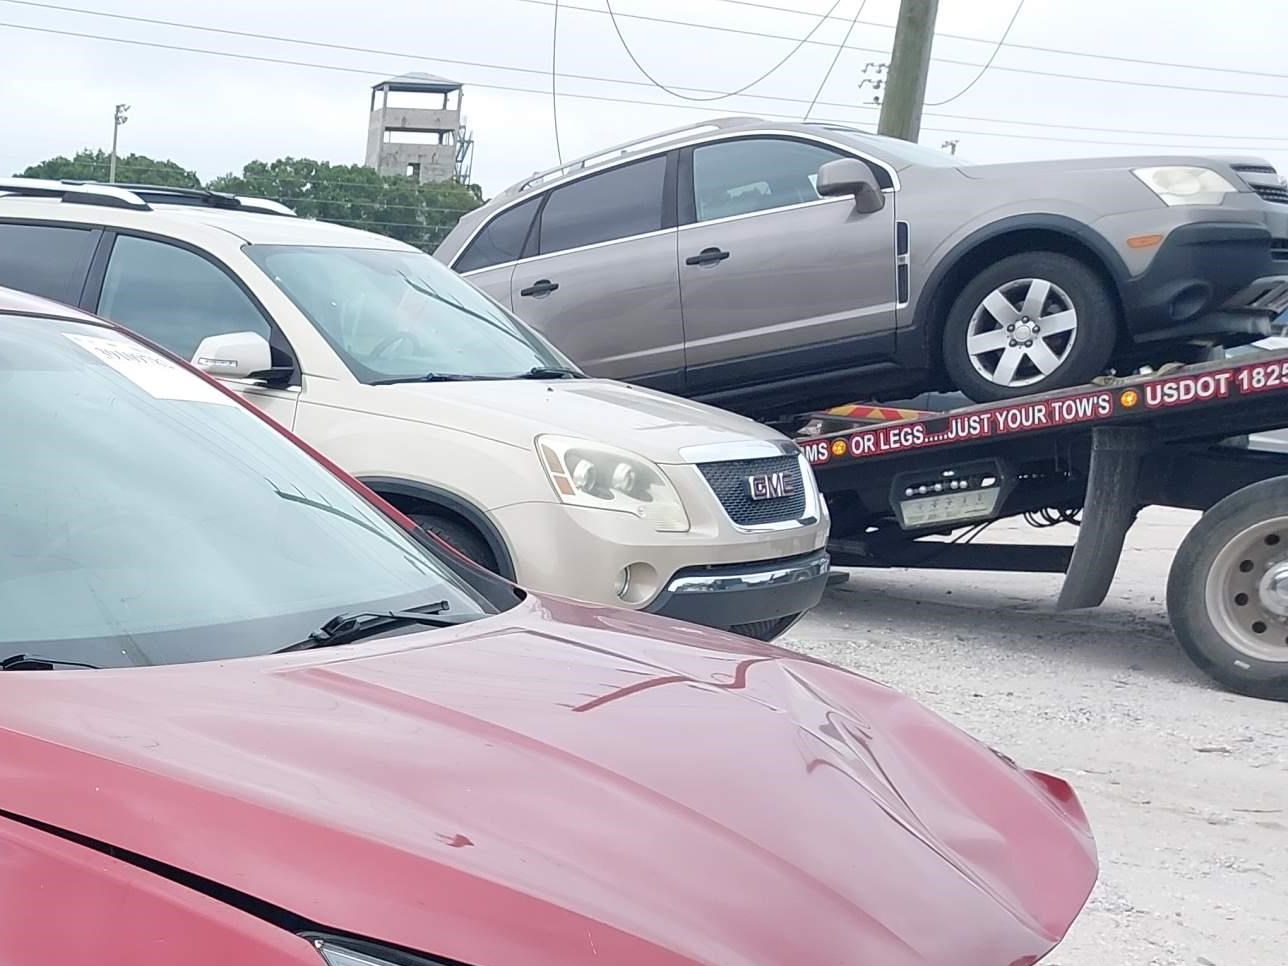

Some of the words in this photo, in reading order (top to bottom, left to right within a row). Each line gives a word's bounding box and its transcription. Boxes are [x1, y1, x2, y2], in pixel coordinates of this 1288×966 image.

[1146, 373, 1230, 405] USDOT
[851, 435, 874, 454] OR
[996, 405, 1046, 431] YOUR
[1051, 394, 1110, 422] TOW'S
